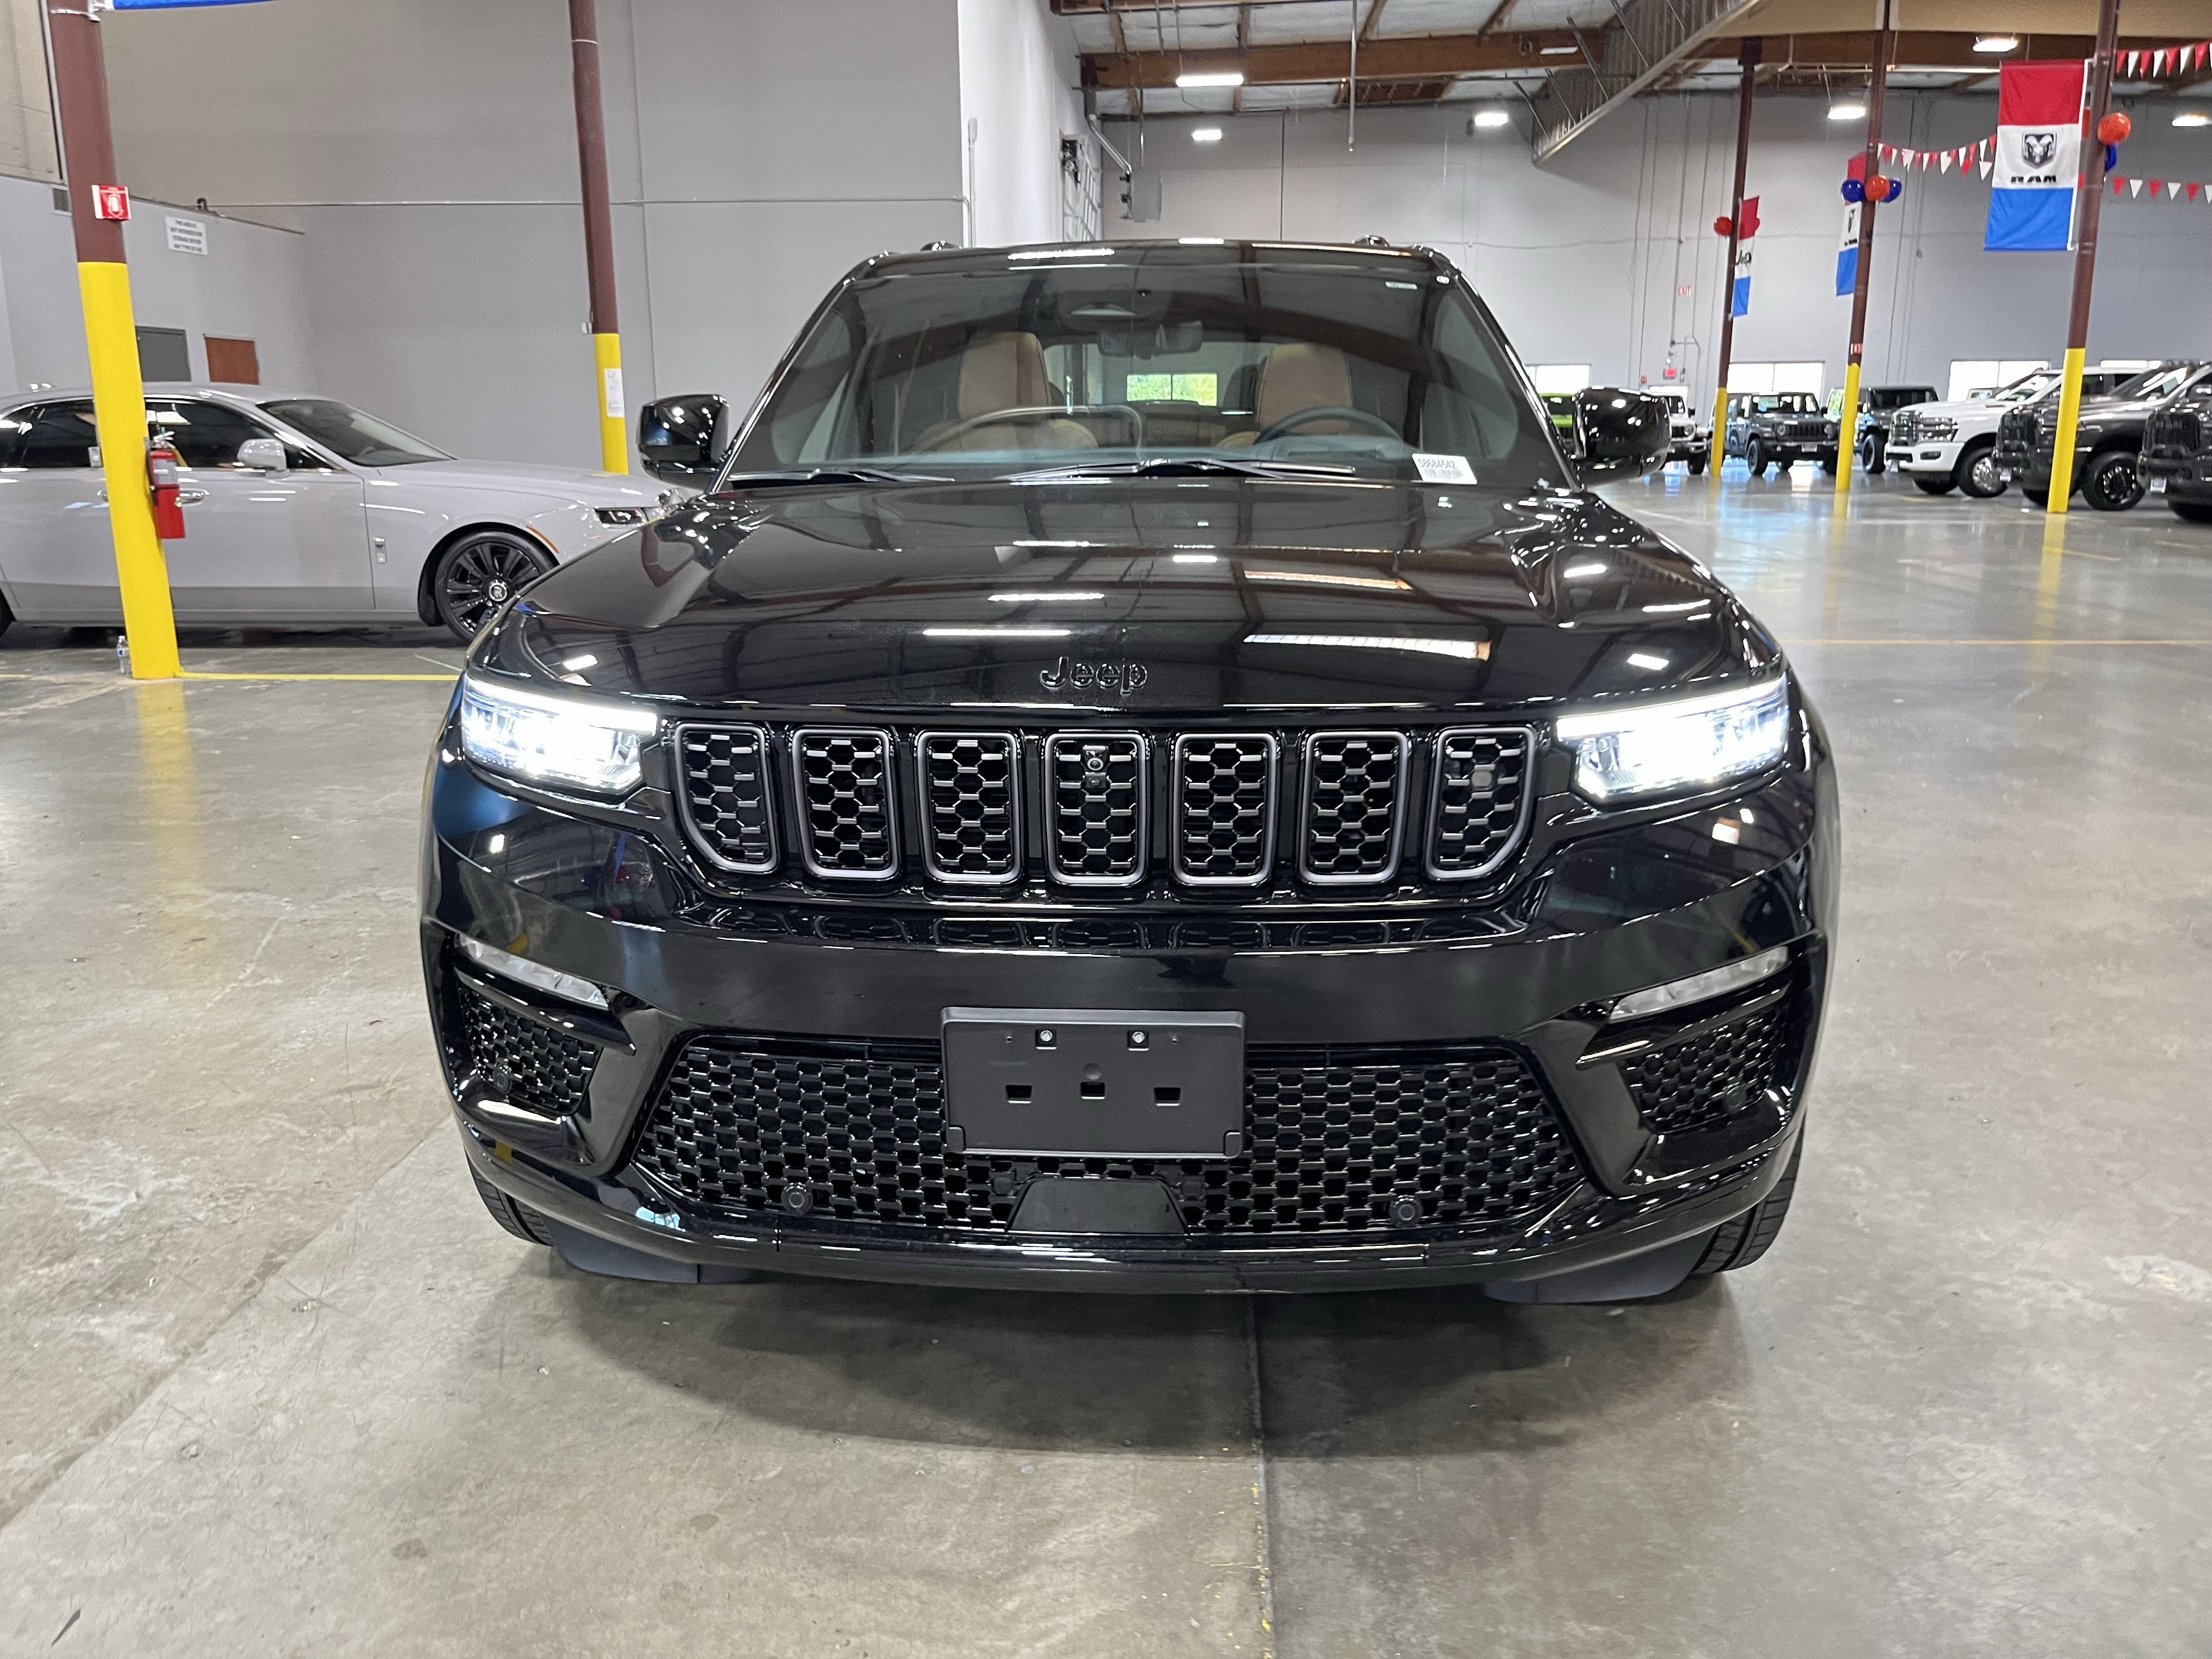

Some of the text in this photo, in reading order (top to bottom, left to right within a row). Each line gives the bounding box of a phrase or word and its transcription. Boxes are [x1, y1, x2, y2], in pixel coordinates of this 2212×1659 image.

[2010, 175, 2057, 184] RAM
[1678, 285, 1691, 297] EXIT
[1040, 656, 1147, 697] Jeep
